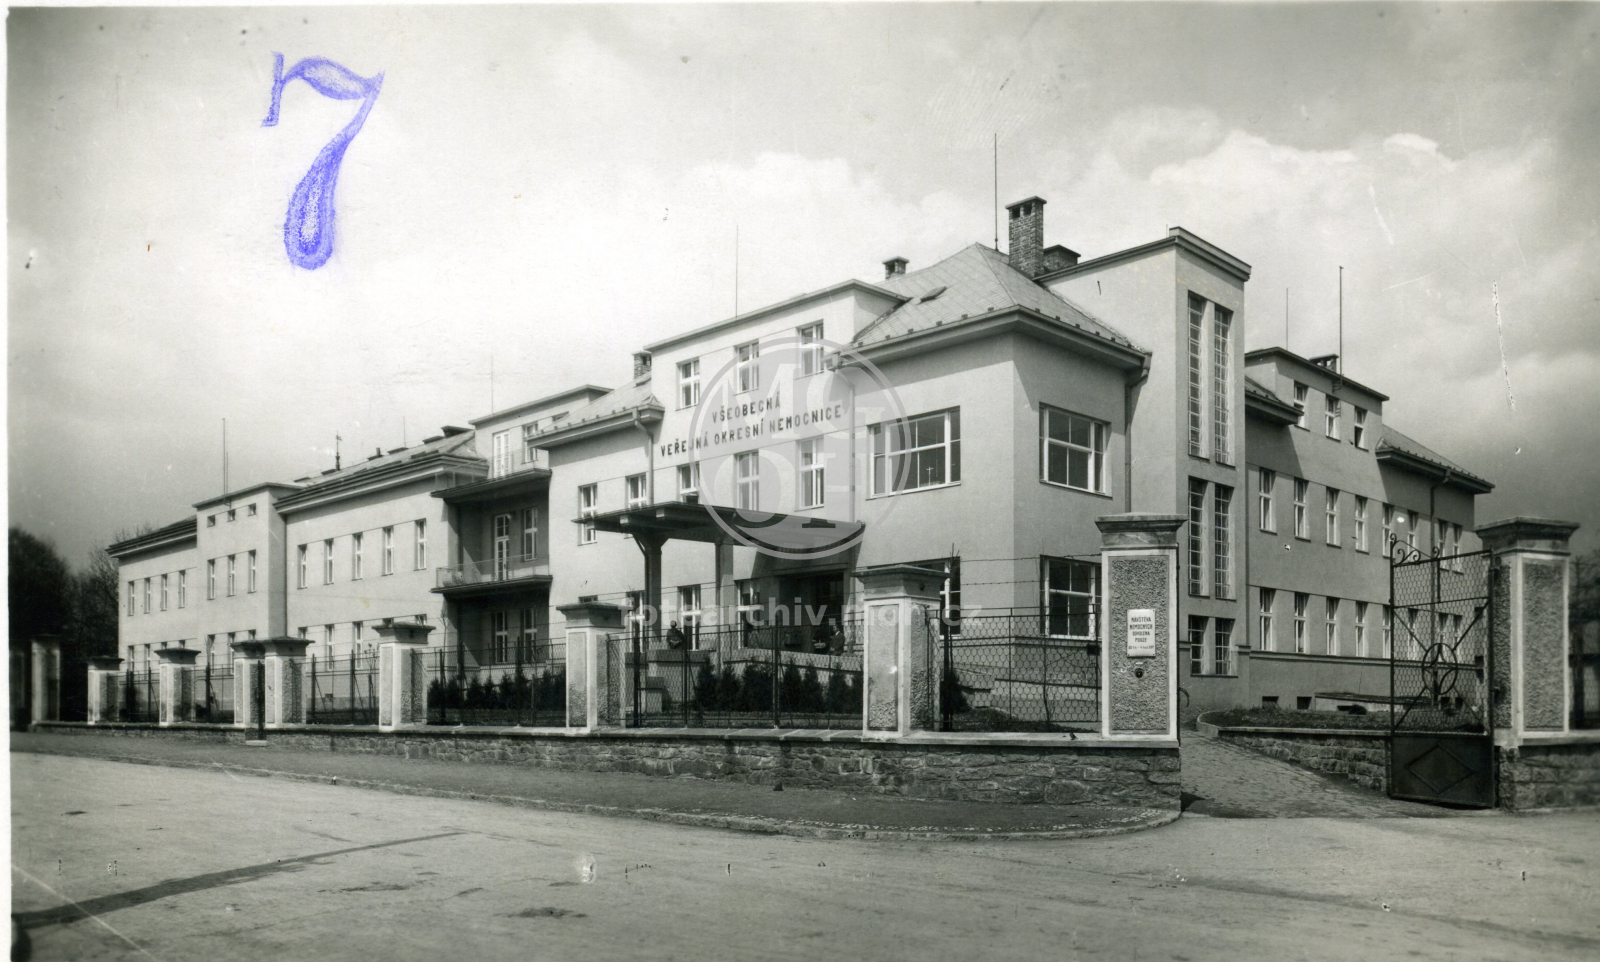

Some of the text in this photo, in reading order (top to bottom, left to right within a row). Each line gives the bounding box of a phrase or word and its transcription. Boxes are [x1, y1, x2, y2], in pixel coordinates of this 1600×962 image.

[260, 51, 386, 271] 7
[660, 404, 842, 457] VEŘEJNÁ OKRESNÍ NEMOCNICE
[712, 391, 781, 423] VŠEOBECNÁ
